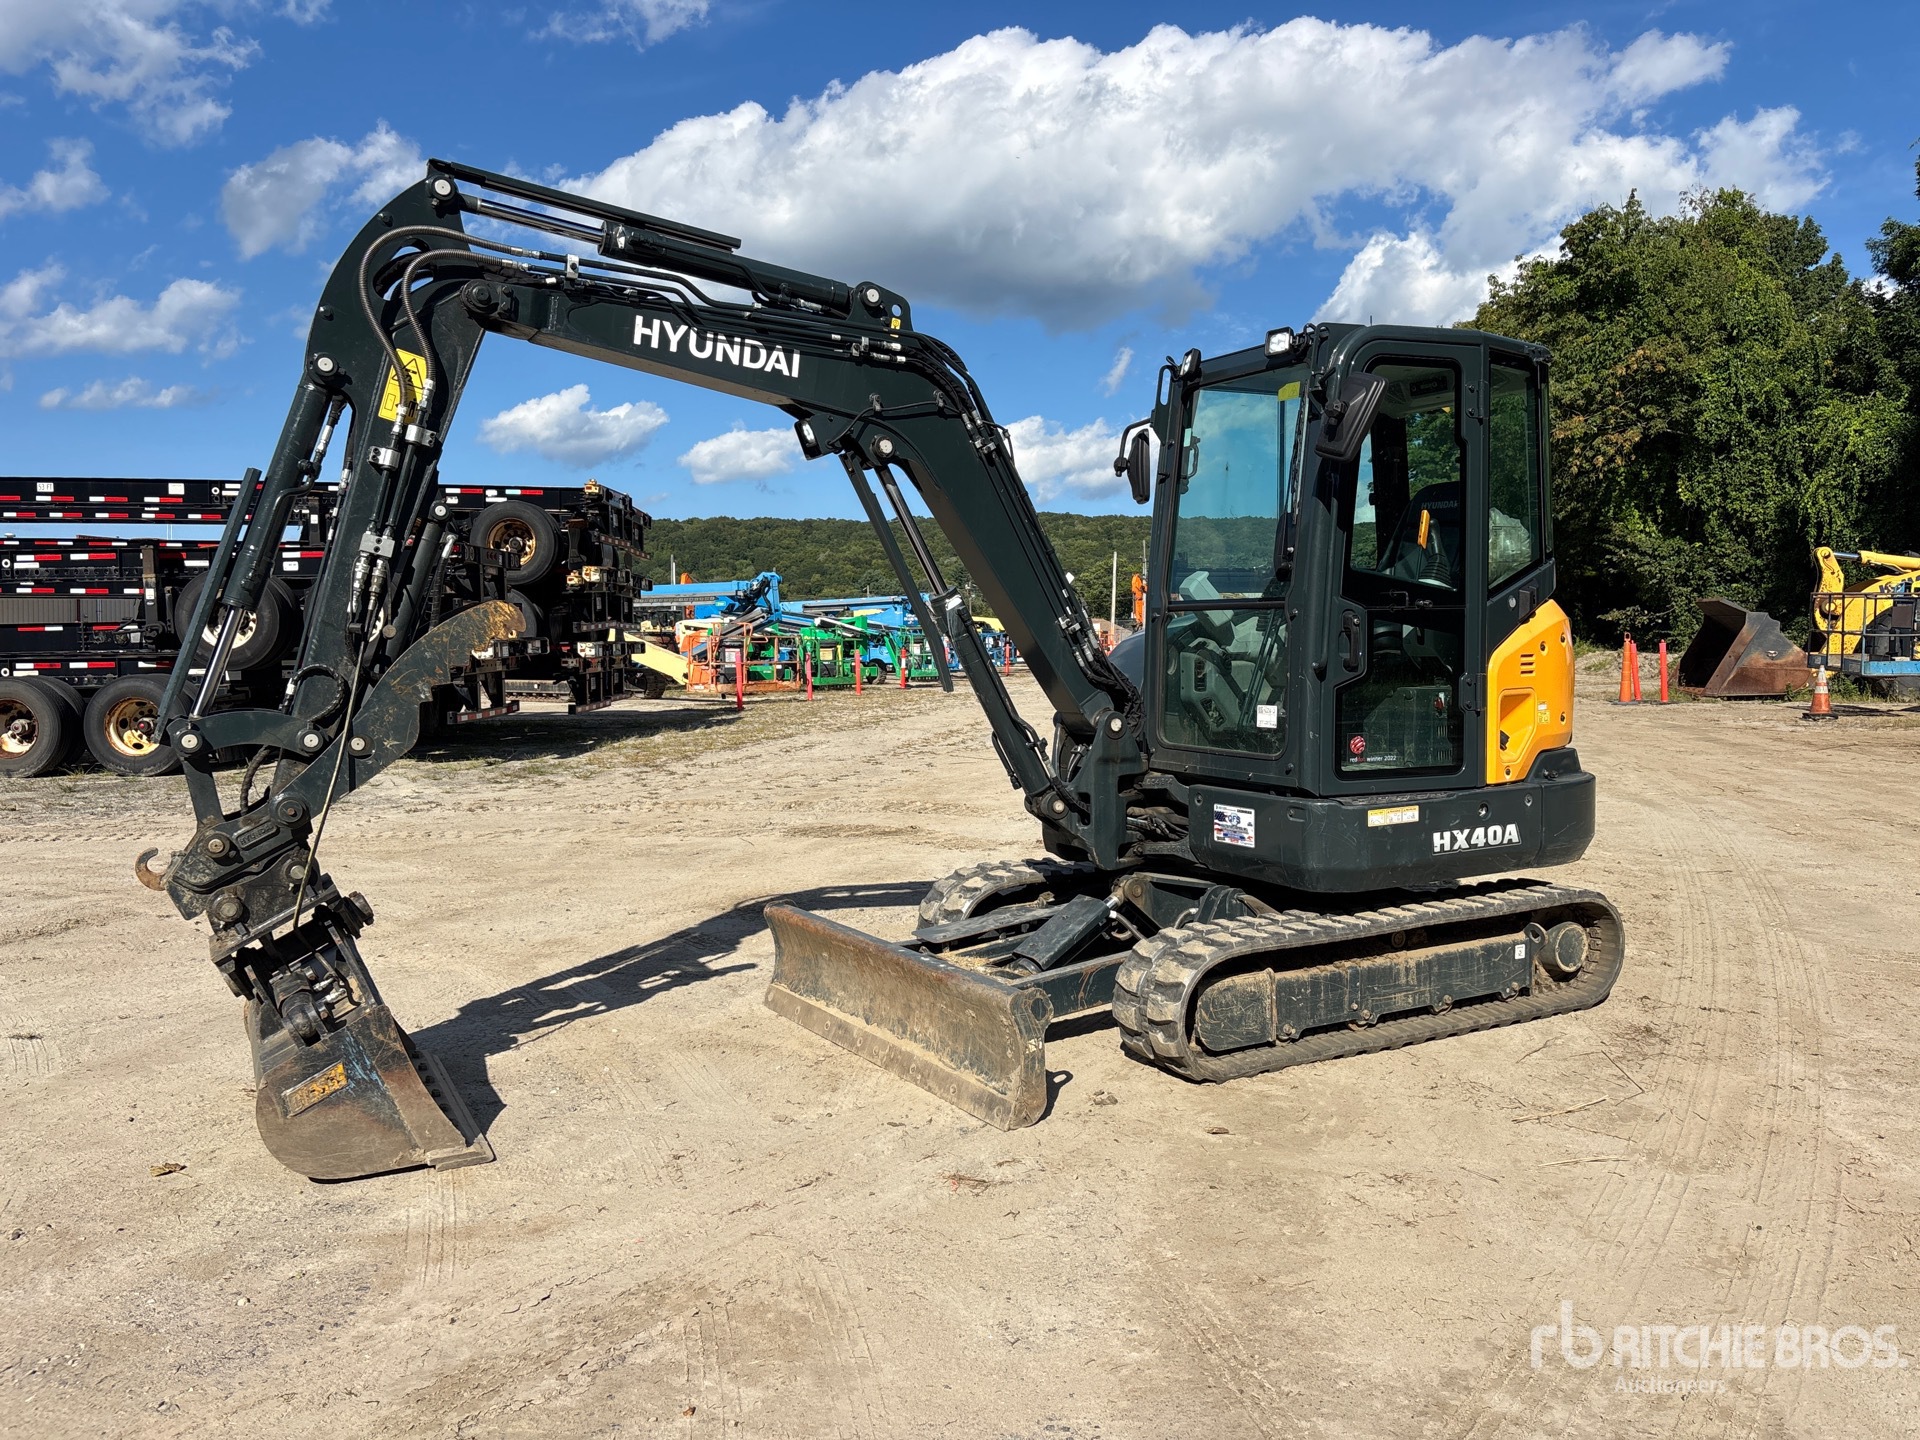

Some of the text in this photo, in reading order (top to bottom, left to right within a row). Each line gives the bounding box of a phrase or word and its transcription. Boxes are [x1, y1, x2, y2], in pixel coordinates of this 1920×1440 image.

[633, 314, 801, 378] HYUNDAI
[38, 483, 52, 491] 53 FT
[1432, 823, 1520, 853] HX40A
